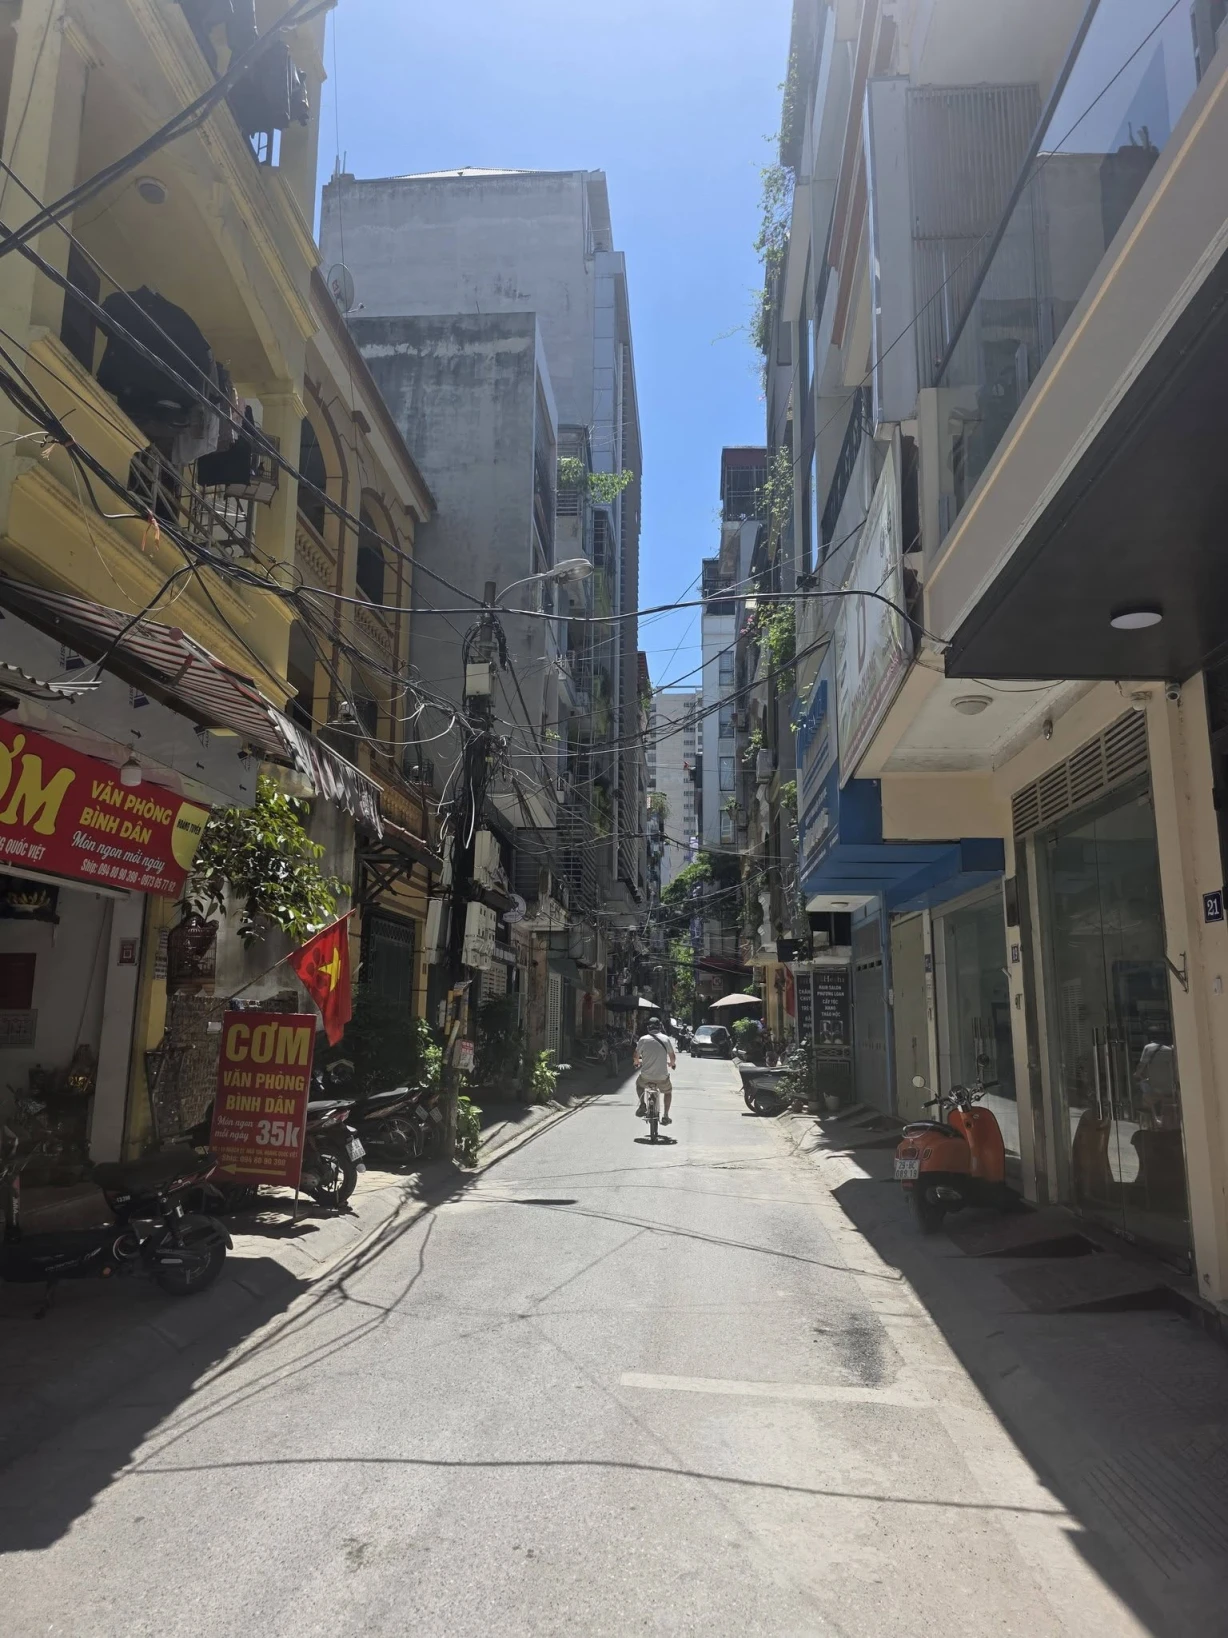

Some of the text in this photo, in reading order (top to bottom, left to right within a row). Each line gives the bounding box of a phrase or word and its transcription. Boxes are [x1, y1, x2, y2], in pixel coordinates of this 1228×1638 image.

[91, 780, 173, 825] VĂN PHÒNG
[79, 805, 152, 845] BÌNH DÂN
[5, 837, 28, 856] QUỐC
[27, 843, 46, 862] VIỆT
[71, 830, 95, 852] Món
[97, 843, 122, 860] ngon
[141, 857, 165, 875] ngày
[1207, 898, 1220, 916] 21
[226, 1021, 311, 1066] CƠM
[223, 1068, 305, 1091] VĂN PHÒNG
[226, 1092, 296, 1115] BÌNH DÂN
[256, 1119, 300, 1148] 35k
